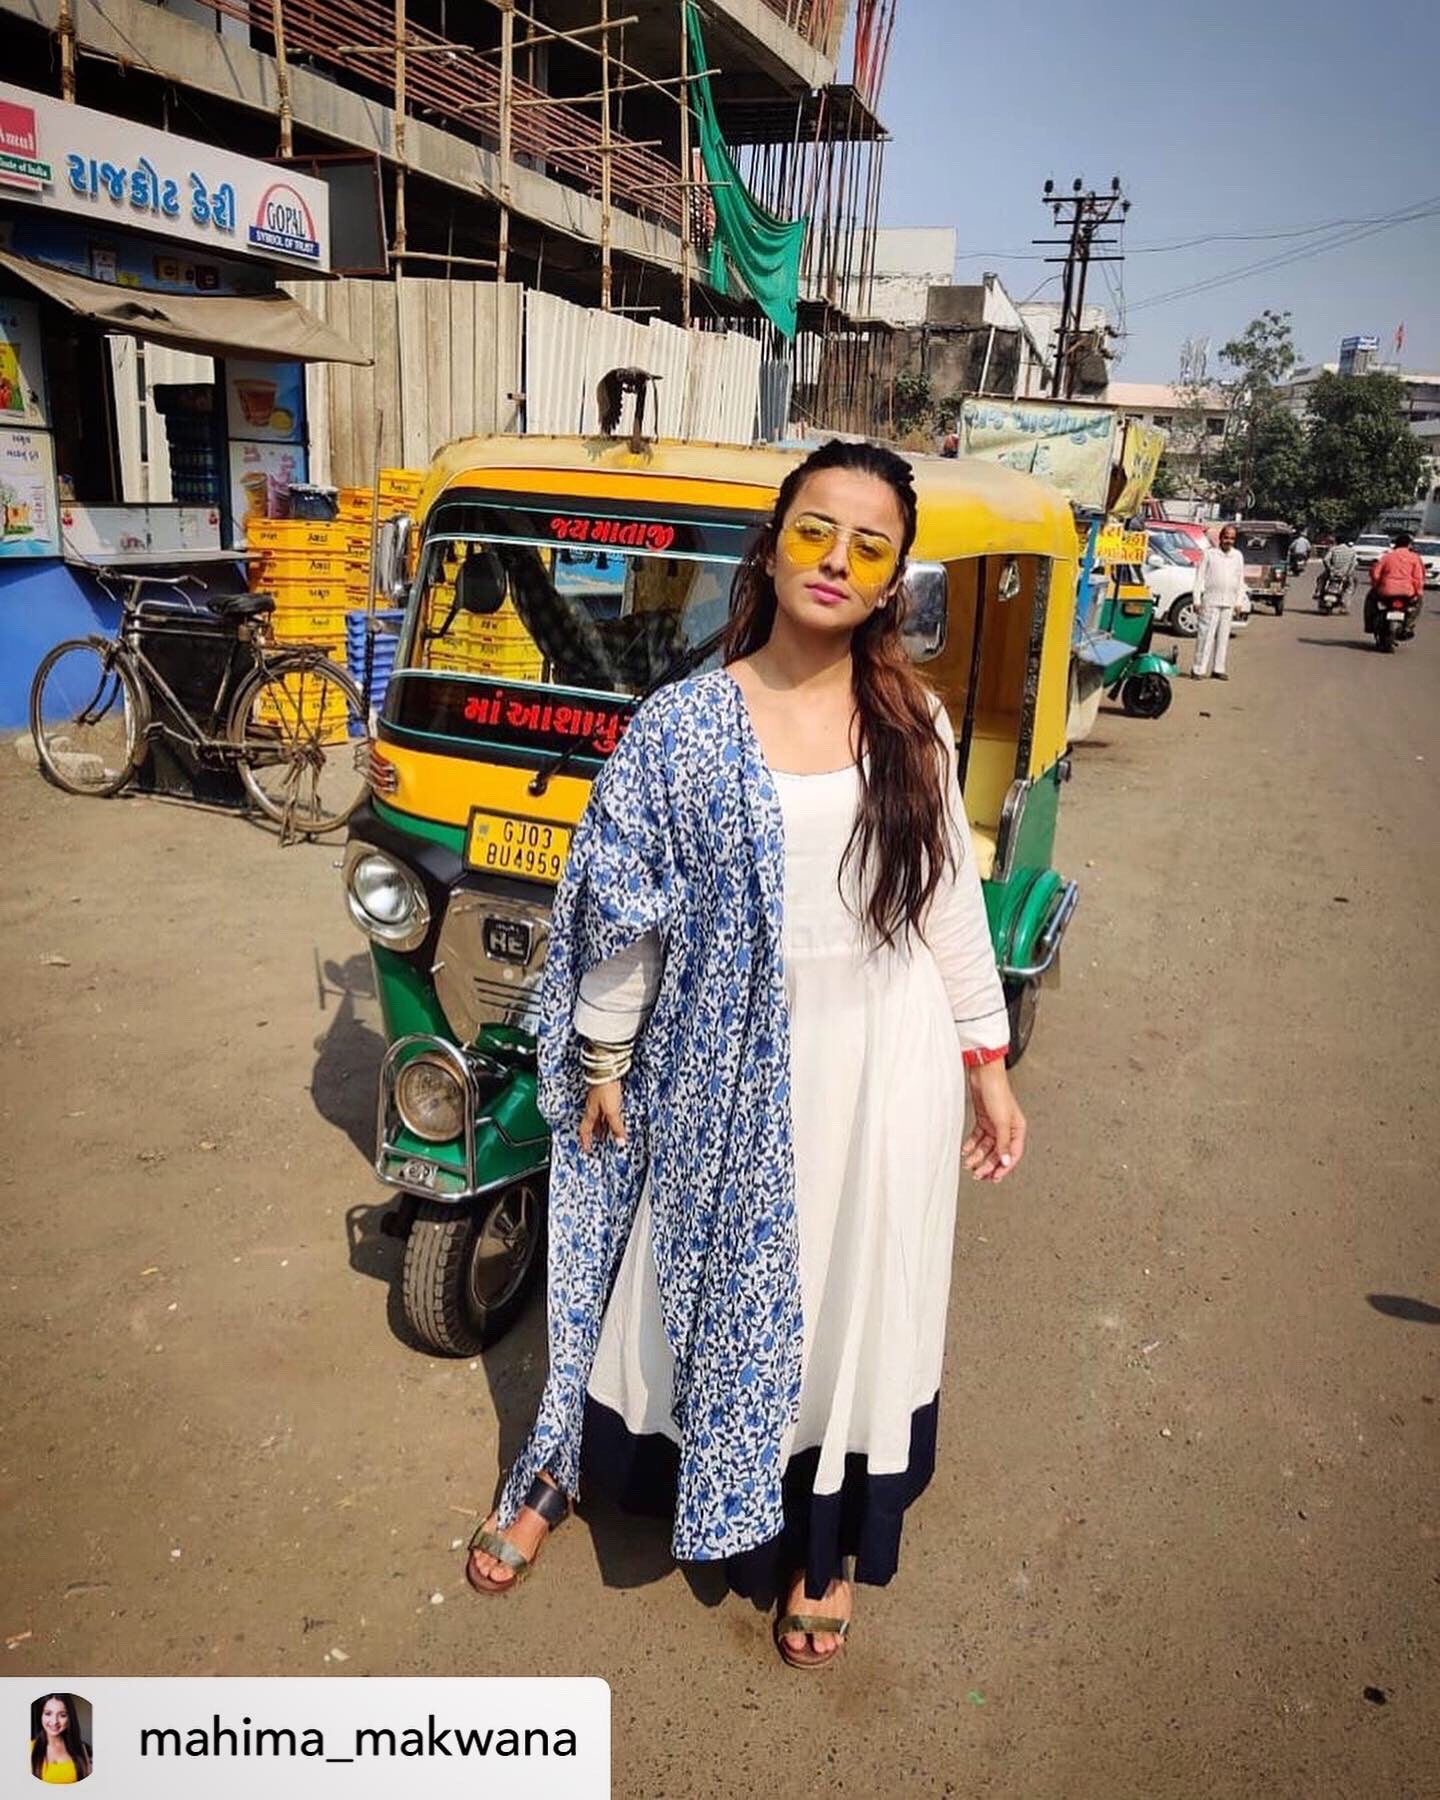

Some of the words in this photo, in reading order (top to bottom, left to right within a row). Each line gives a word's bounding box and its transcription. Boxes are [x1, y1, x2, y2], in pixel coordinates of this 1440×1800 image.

[67, 154, 181, 215] રાજકોટ
[190, 171, 236, 231] ડેરી
[266, 201, 306, 238] GOPAL
[256, 229, 284, 247] SYMBOL
[284, 237, 294, 249] OF
[294, 240, 315, 254] TRUST
[551, 517, 590, 541] જય
[590, 521, 674, 552] માતાજી
[464, 689, 503, 724] માં
[503, 821, 552, 849] GJ03
[486, 843, 560, 876] BU4959
